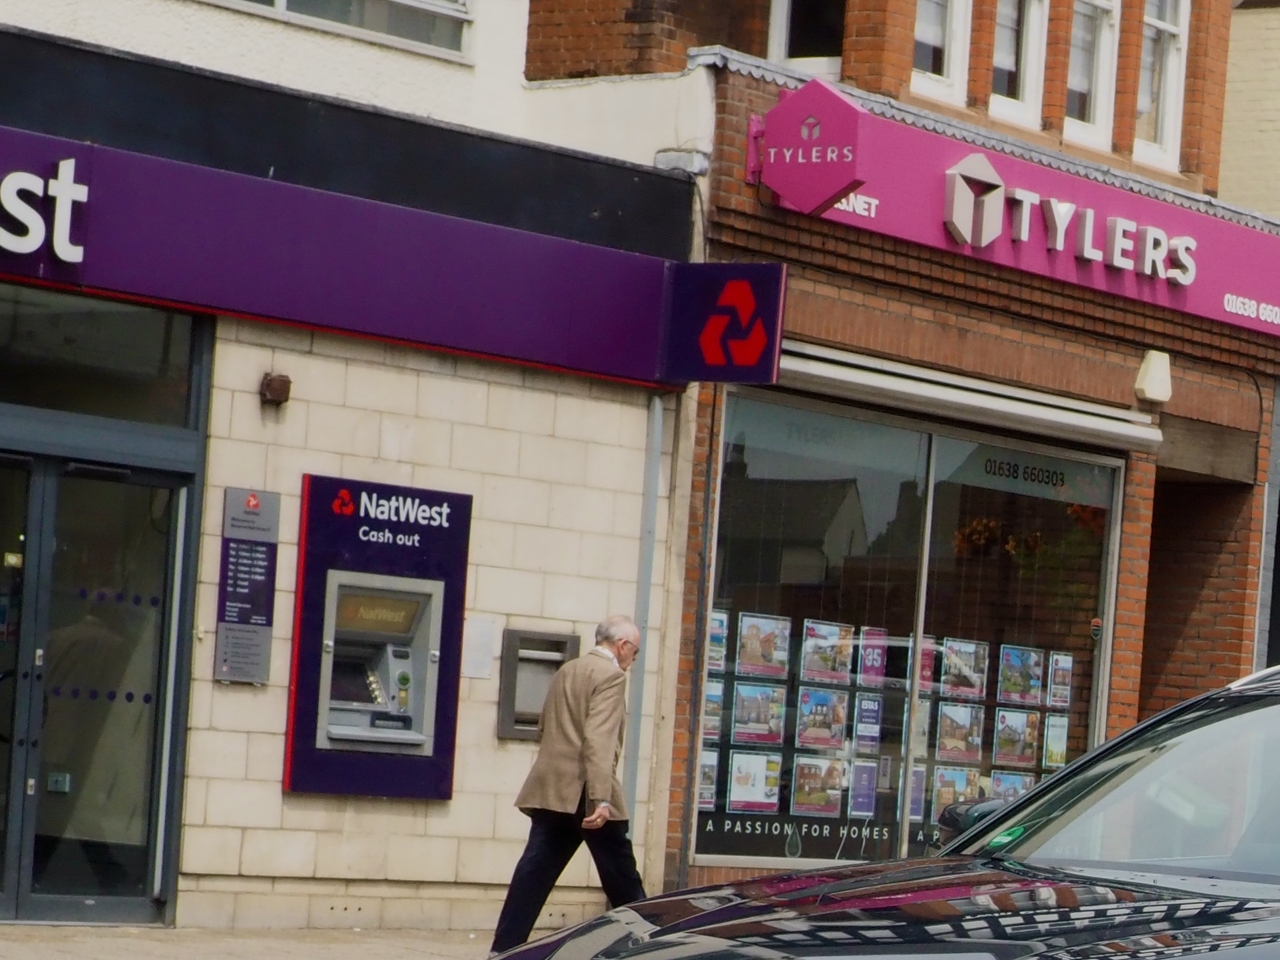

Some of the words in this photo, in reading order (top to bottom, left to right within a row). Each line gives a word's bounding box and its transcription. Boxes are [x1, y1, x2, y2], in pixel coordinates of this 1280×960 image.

[768, 146, 853, 163] TYLERS
[1006, 187, 1197, 286] TYLERS
[1224, 293, 1257, 318] 01638
[985, 458, 1019, 479] 01638
[1023, 465, 1065, 487] 660303
[359, 491, 450, 528] NatWest
[359, 526, 393, 545] Cash
[396, 532, 420, 547] out
[358, 605, 405, 623] NatWest
[706, 819, 714, 832] A
[724, 819, 793, 835] PASSION
[802, 823, 830, 837] FOR
[839, 826, 889, 840] HOMES
[917, 829, 924, 841] A
